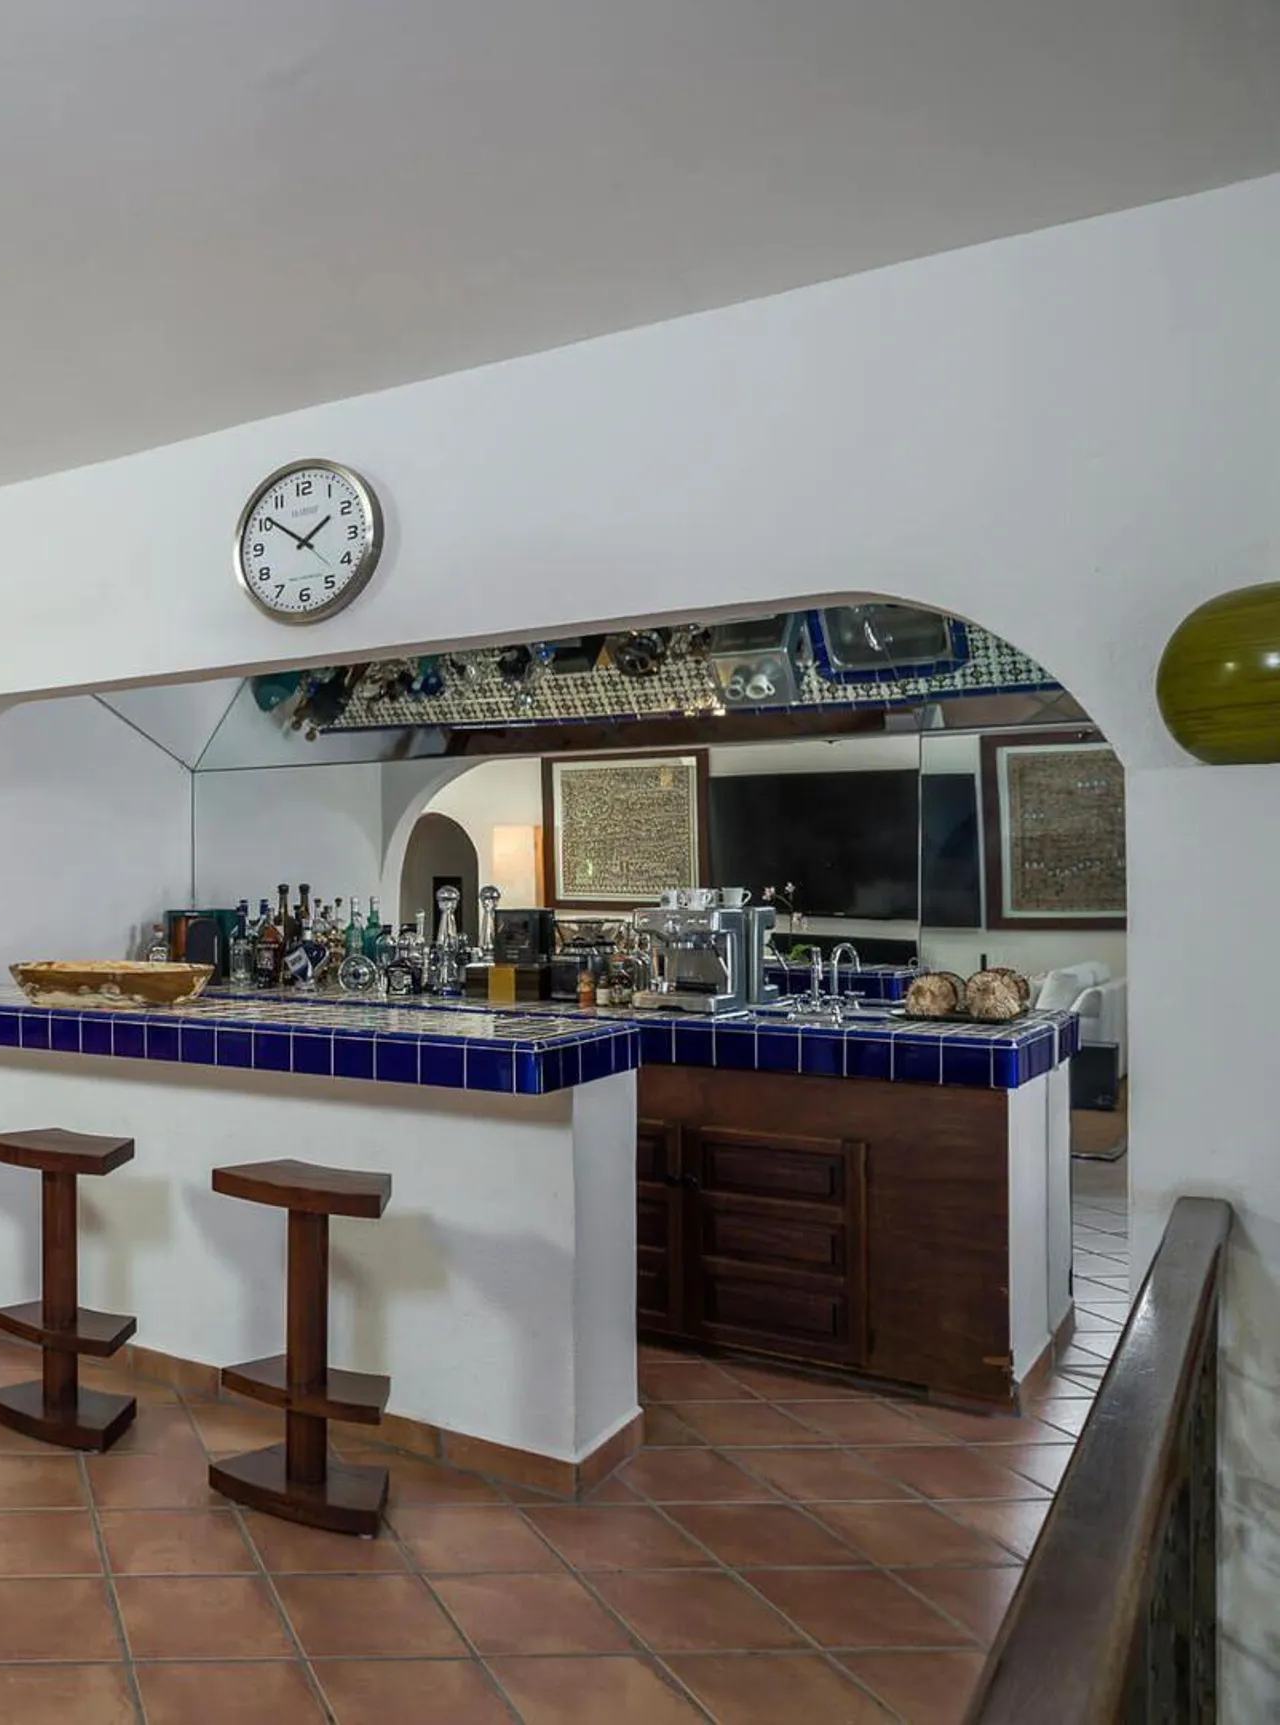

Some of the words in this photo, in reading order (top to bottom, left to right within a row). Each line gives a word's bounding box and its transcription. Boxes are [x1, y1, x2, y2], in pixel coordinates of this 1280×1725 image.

[296, 480, 313, 497] 12
[275, 495, 284, 509] 11
[340, 500, 352, 515] 2
[260, 518, 273, 532] 10
[348, 525, 358, 540] 3
[253, 543, 264, 557] 9
[340, 551, 352, 564] 4
[259, 567, 270, 581] 8
[324, 575, 335, 589] 5
[275, 585, 285, 599] 7
[299, 588, 311, 602] 6
